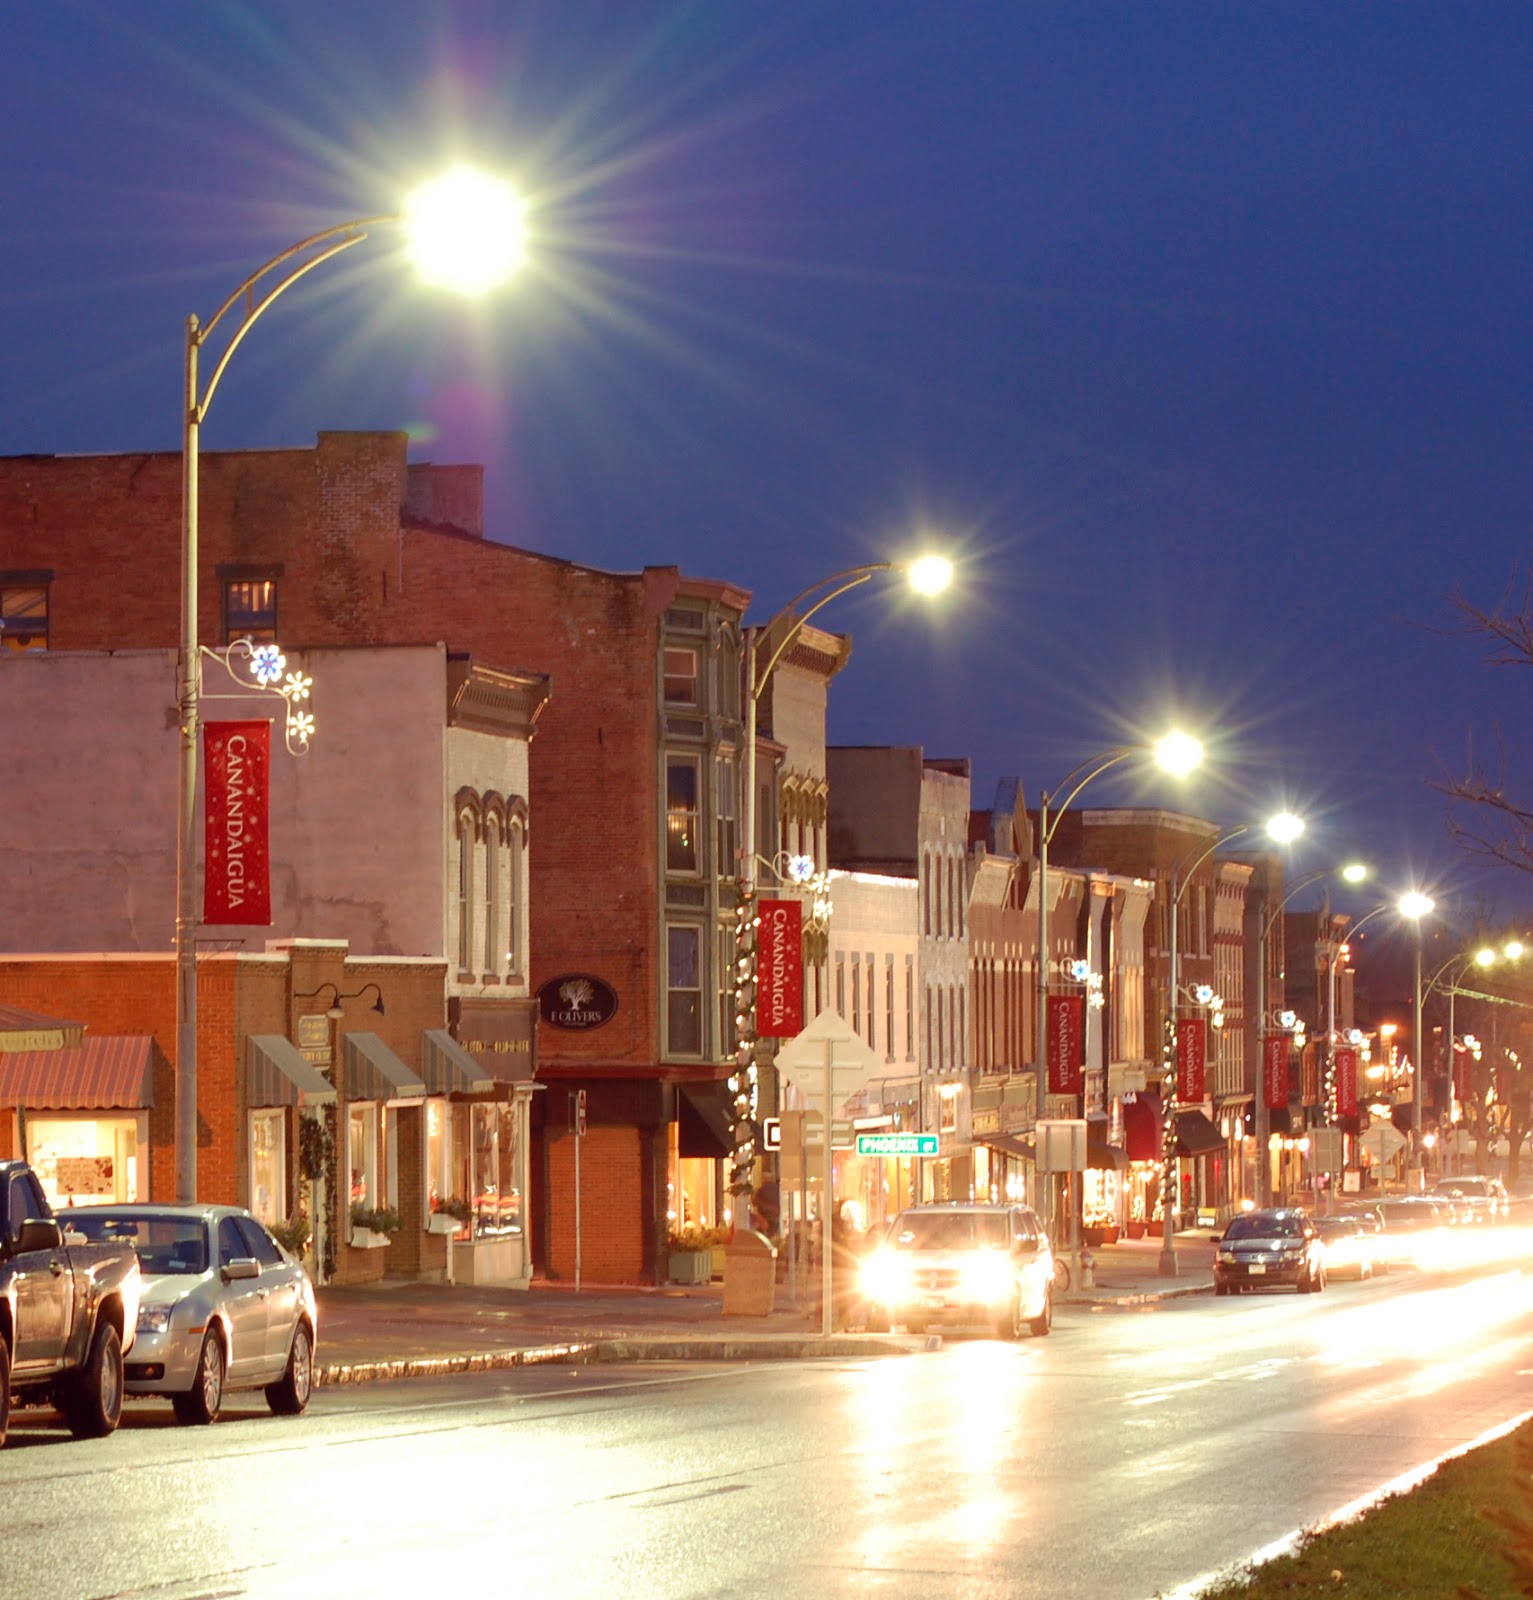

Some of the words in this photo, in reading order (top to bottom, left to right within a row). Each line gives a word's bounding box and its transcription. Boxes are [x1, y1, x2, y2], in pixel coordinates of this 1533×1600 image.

[227, 735, 247, 909] CANANDAIGUA
[772, 908, 787, 1027] CANANDAIGUA
[559, 1010, 601, 1021] OLIVERS
[1059, 1002, 1069, 1088] CANANDAIGUA
[861, 1137, 919, 1153] PHOENIX
